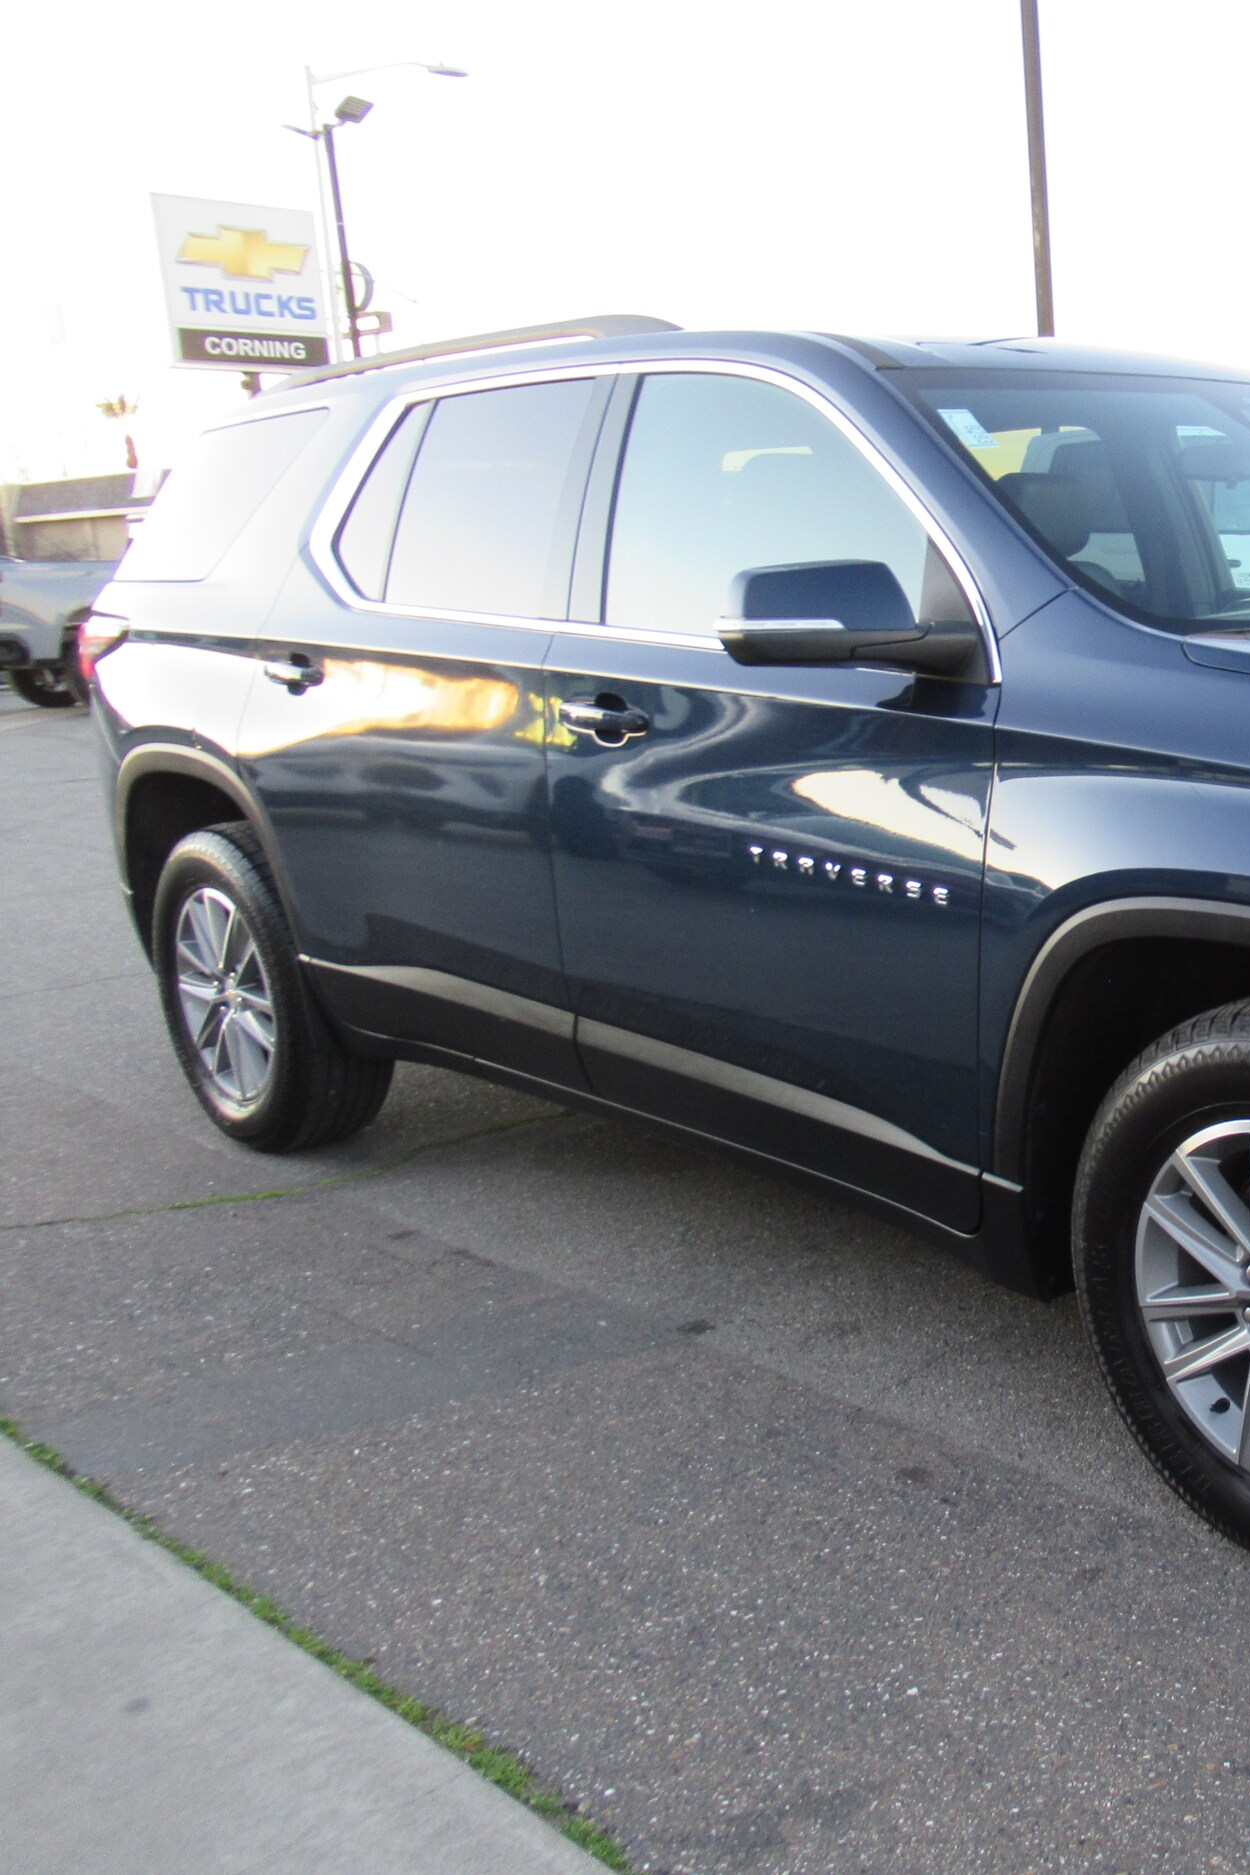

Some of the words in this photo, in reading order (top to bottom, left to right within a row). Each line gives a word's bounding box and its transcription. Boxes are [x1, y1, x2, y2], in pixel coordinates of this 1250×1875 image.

[180, 286, 318, 320] TRUCKS
[204, 336, 306, 360] CORNING
[749, 845, 949, 906] TRAVERSE
